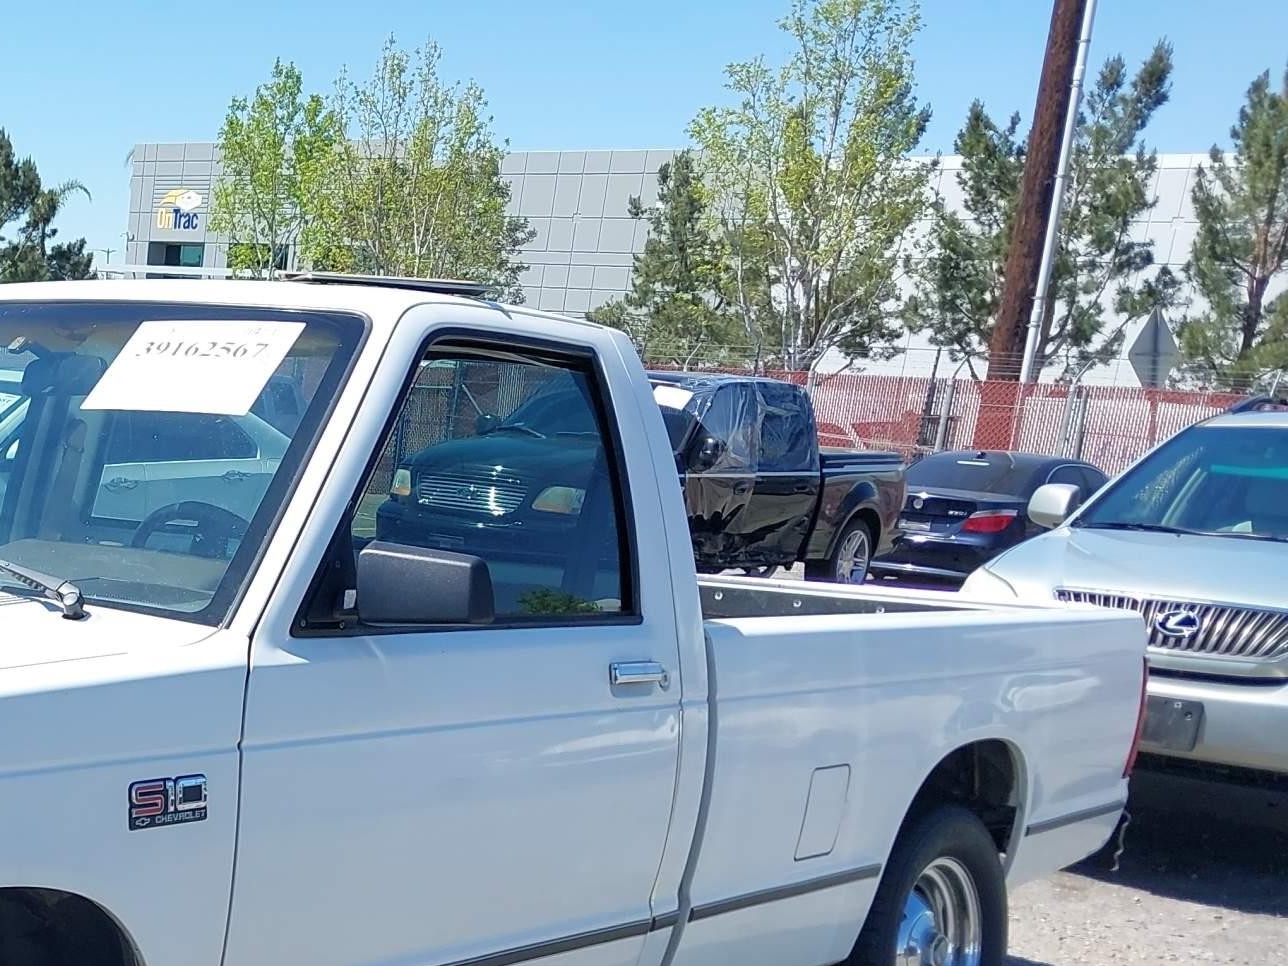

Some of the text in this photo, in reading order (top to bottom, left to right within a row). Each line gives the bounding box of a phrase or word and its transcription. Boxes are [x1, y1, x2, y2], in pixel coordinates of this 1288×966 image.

[156, 207, 199, 230] OnTrac
[136, 341, 268, 358] 39162567
[154, 809, 206, 824] CHEVROLET
